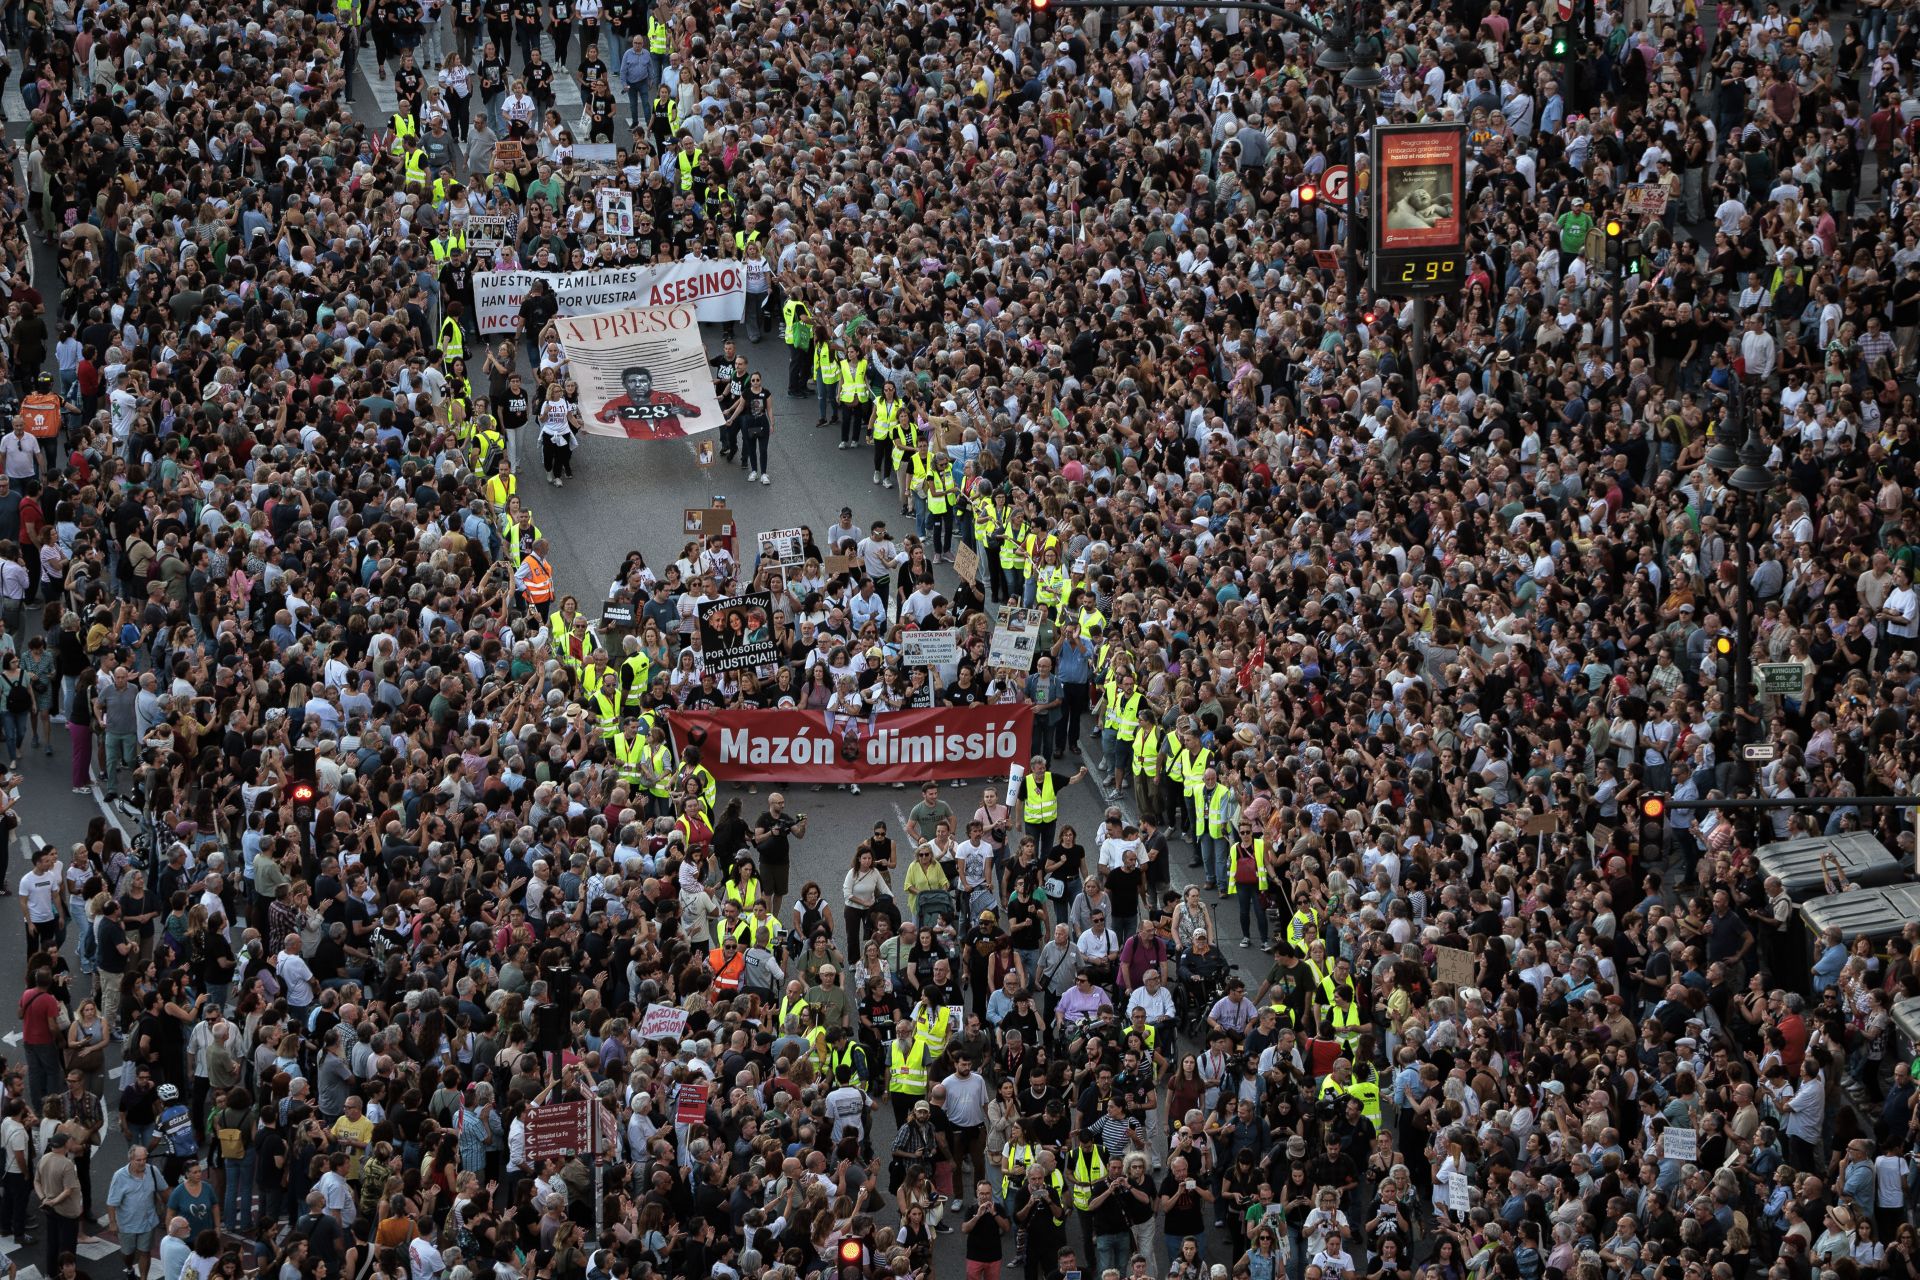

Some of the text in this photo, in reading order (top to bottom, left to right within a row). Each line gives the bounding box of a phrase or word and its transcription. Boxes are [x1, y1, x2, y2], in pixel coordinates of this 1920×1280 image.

[470, 216, 505, 224] JUSTICIA
[558, 272, 637, 289] FAMILIARES
[650, 268, 743, 307] ASESINOS
[481, 295, 505, 307] HAN
[558, 297, 582, 307] POR
[586, 291, 637, 306] VUESTRA
[566, 304, 691, 342] A PRESÓ
[624, 405, 669, 419] 228
[760, 529, 801, 541] JUSTICIA
[702, 597, 769, 622] ESTAMOS AQUÍ
[705, 640, 774, 660] POR VOSOTROS
[719, 720, 1016, 765] Mazón dimissió
[745, 955, 759, 966] PRESS
[537, 1132, 556, 1140] Hospital
